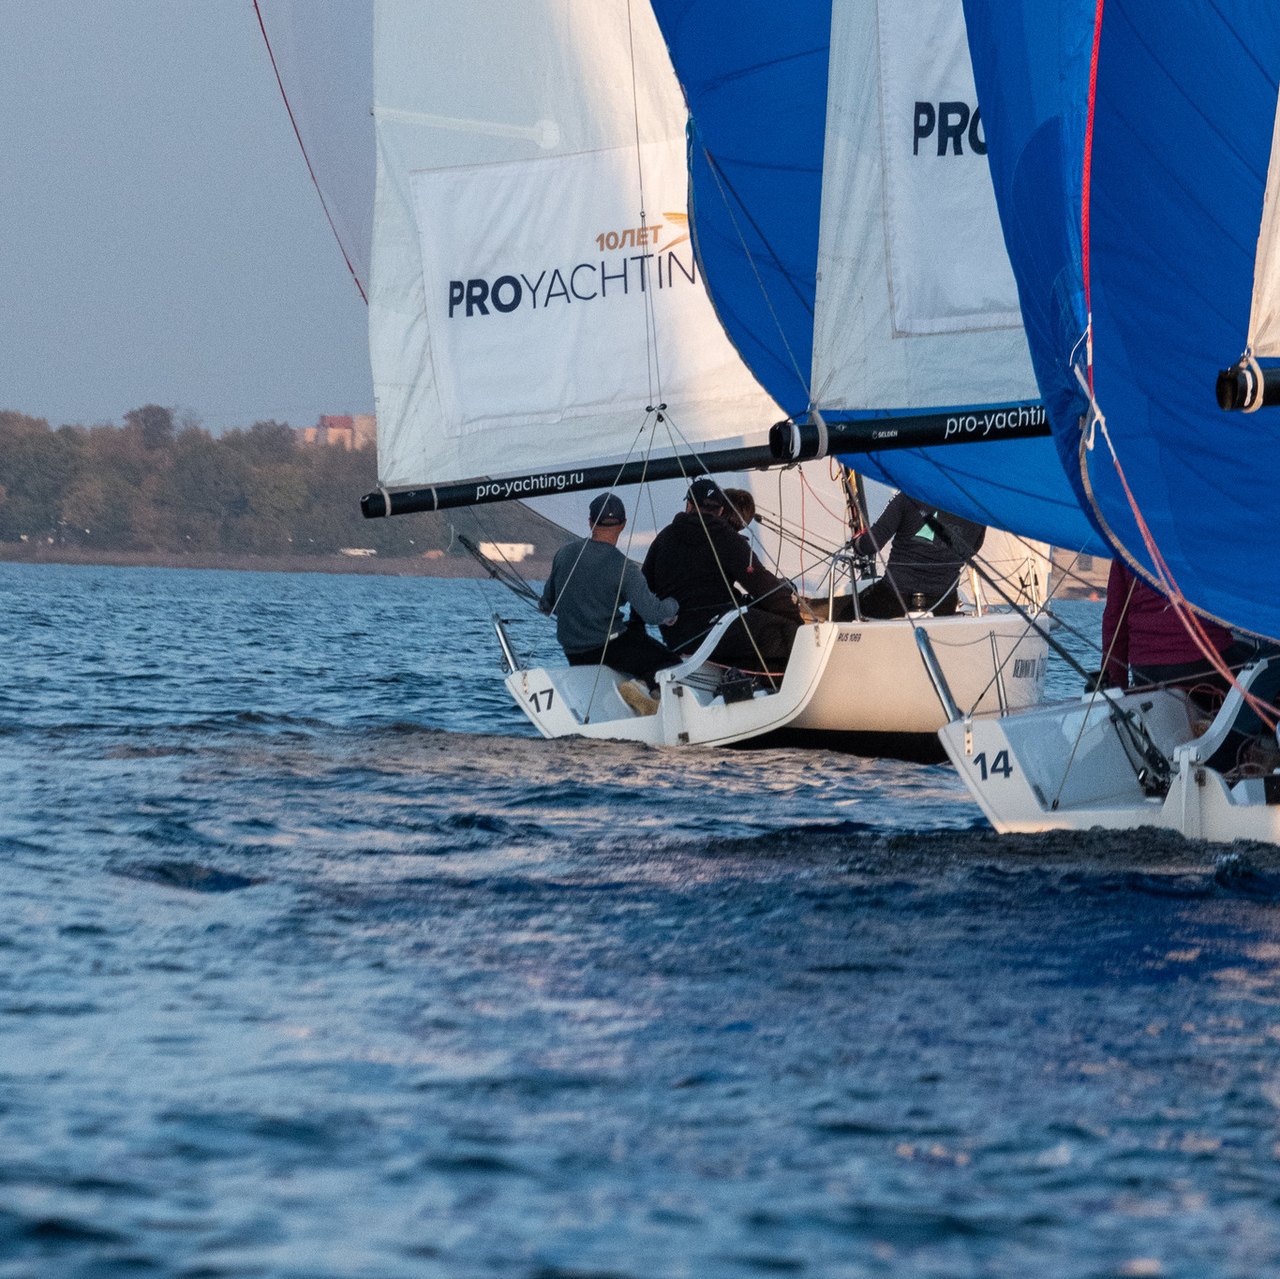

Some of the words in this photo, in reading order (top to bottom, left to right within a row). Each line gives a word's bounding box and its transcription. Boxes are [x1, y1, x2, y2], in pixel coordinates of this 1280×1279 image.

[476, 472, 584, 500] pro-yachting.ru
[529, 688, 554, 713] 17
[973, 749, 1013, 781] 14
